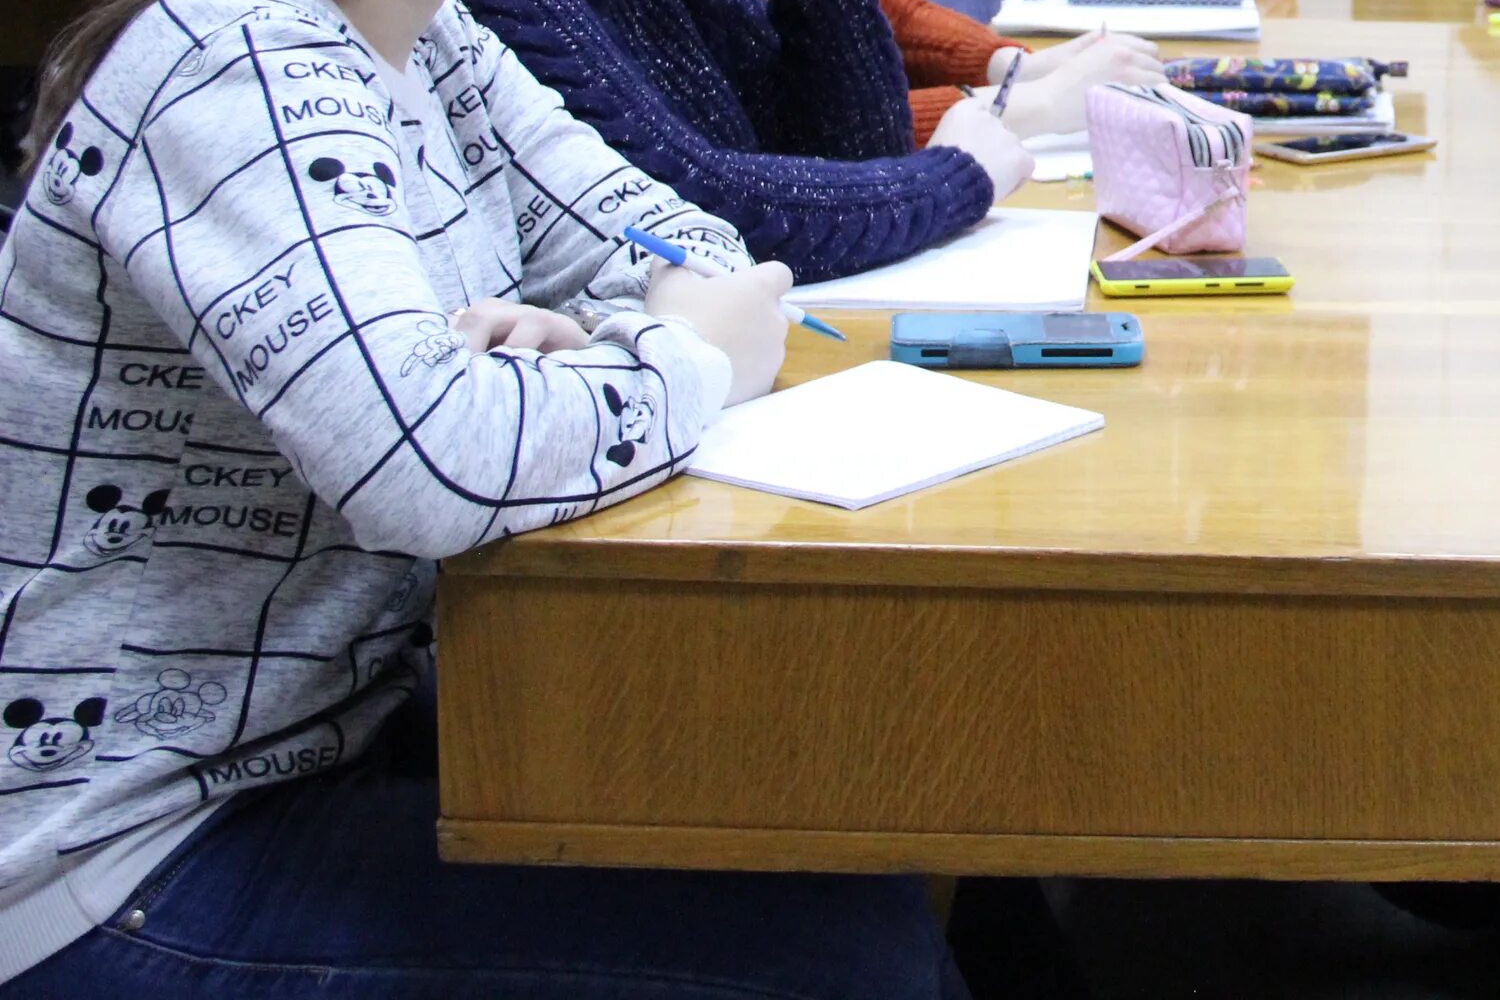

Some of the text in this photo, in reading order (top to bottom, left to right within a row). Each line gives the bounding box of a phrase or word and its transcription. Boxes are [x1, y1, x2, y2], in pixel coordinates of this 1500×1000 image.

[283, 62, 376, 88] CKEY
[216, 262, 296, 340] CKEY
[236, 293, 334, 393] MOUSE
[119, 363, 206, 389] CKE
[184, 464, 293, 488] CKEY
[160, 506, 299, 537] MOUSE
[210, 746, 336, 784] MOUSE
